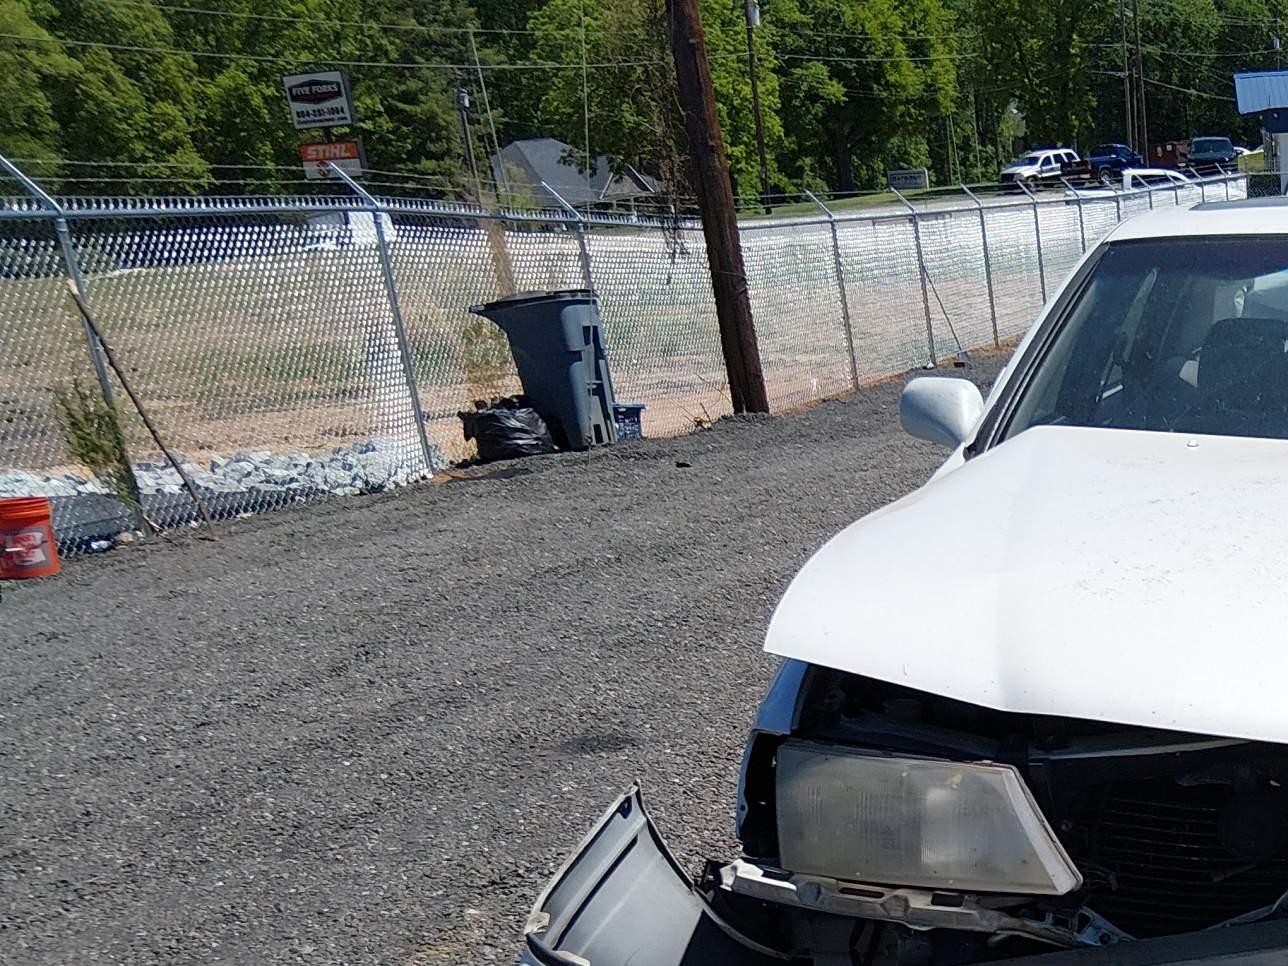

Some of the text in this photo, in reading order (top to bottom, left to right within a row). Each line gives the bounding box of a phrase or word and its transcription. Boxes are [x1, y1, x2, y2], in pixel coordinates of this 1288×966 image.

[292, 86, 311, 97] FIVE
[312, 84, 338, 94] FORKS
[306, 144, 351, 159] STIHL
